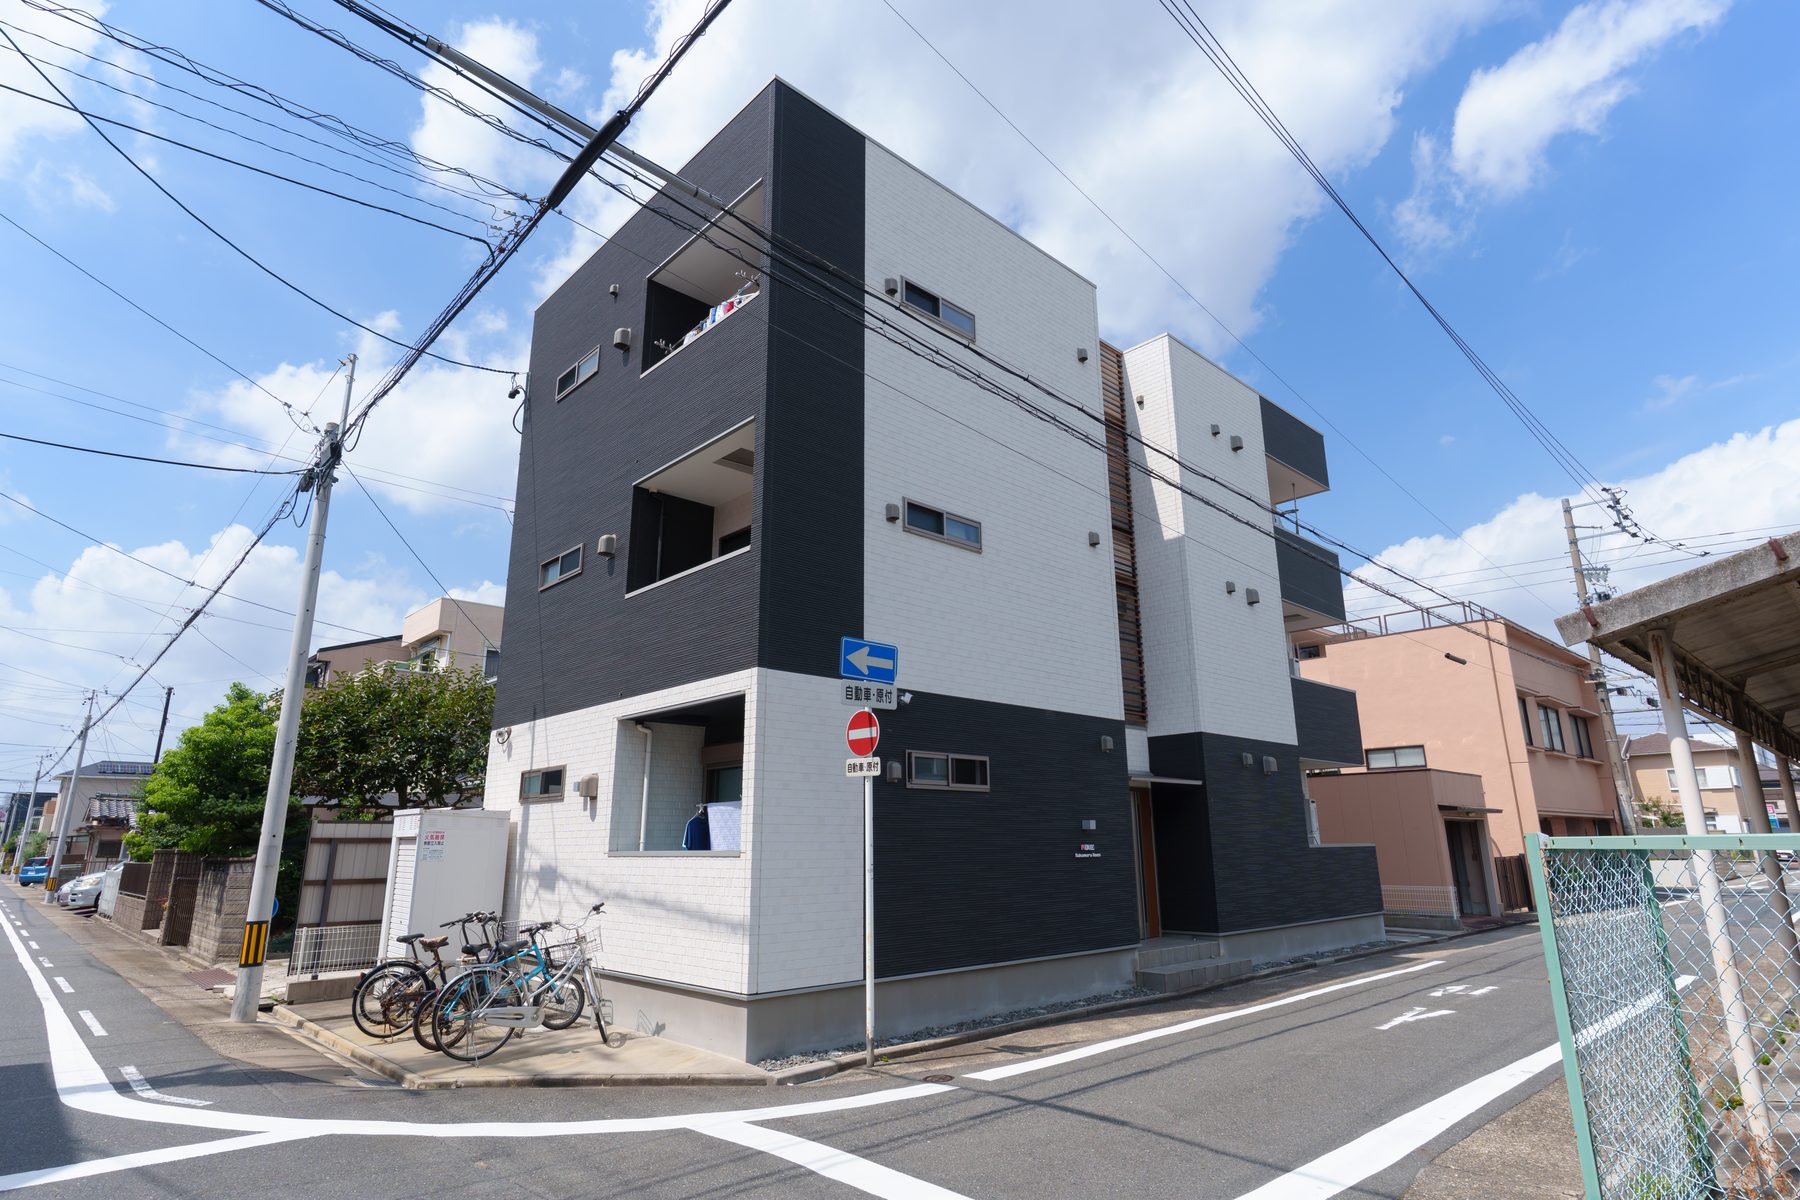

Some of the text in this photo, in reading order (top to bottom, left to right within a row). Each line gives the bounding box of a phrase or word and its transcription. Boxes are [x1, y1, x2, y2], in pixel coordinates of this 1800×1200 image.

[846, 685, 893, 704] 自動車・原付
[848, 761, 879, 773] 自動車・原付
